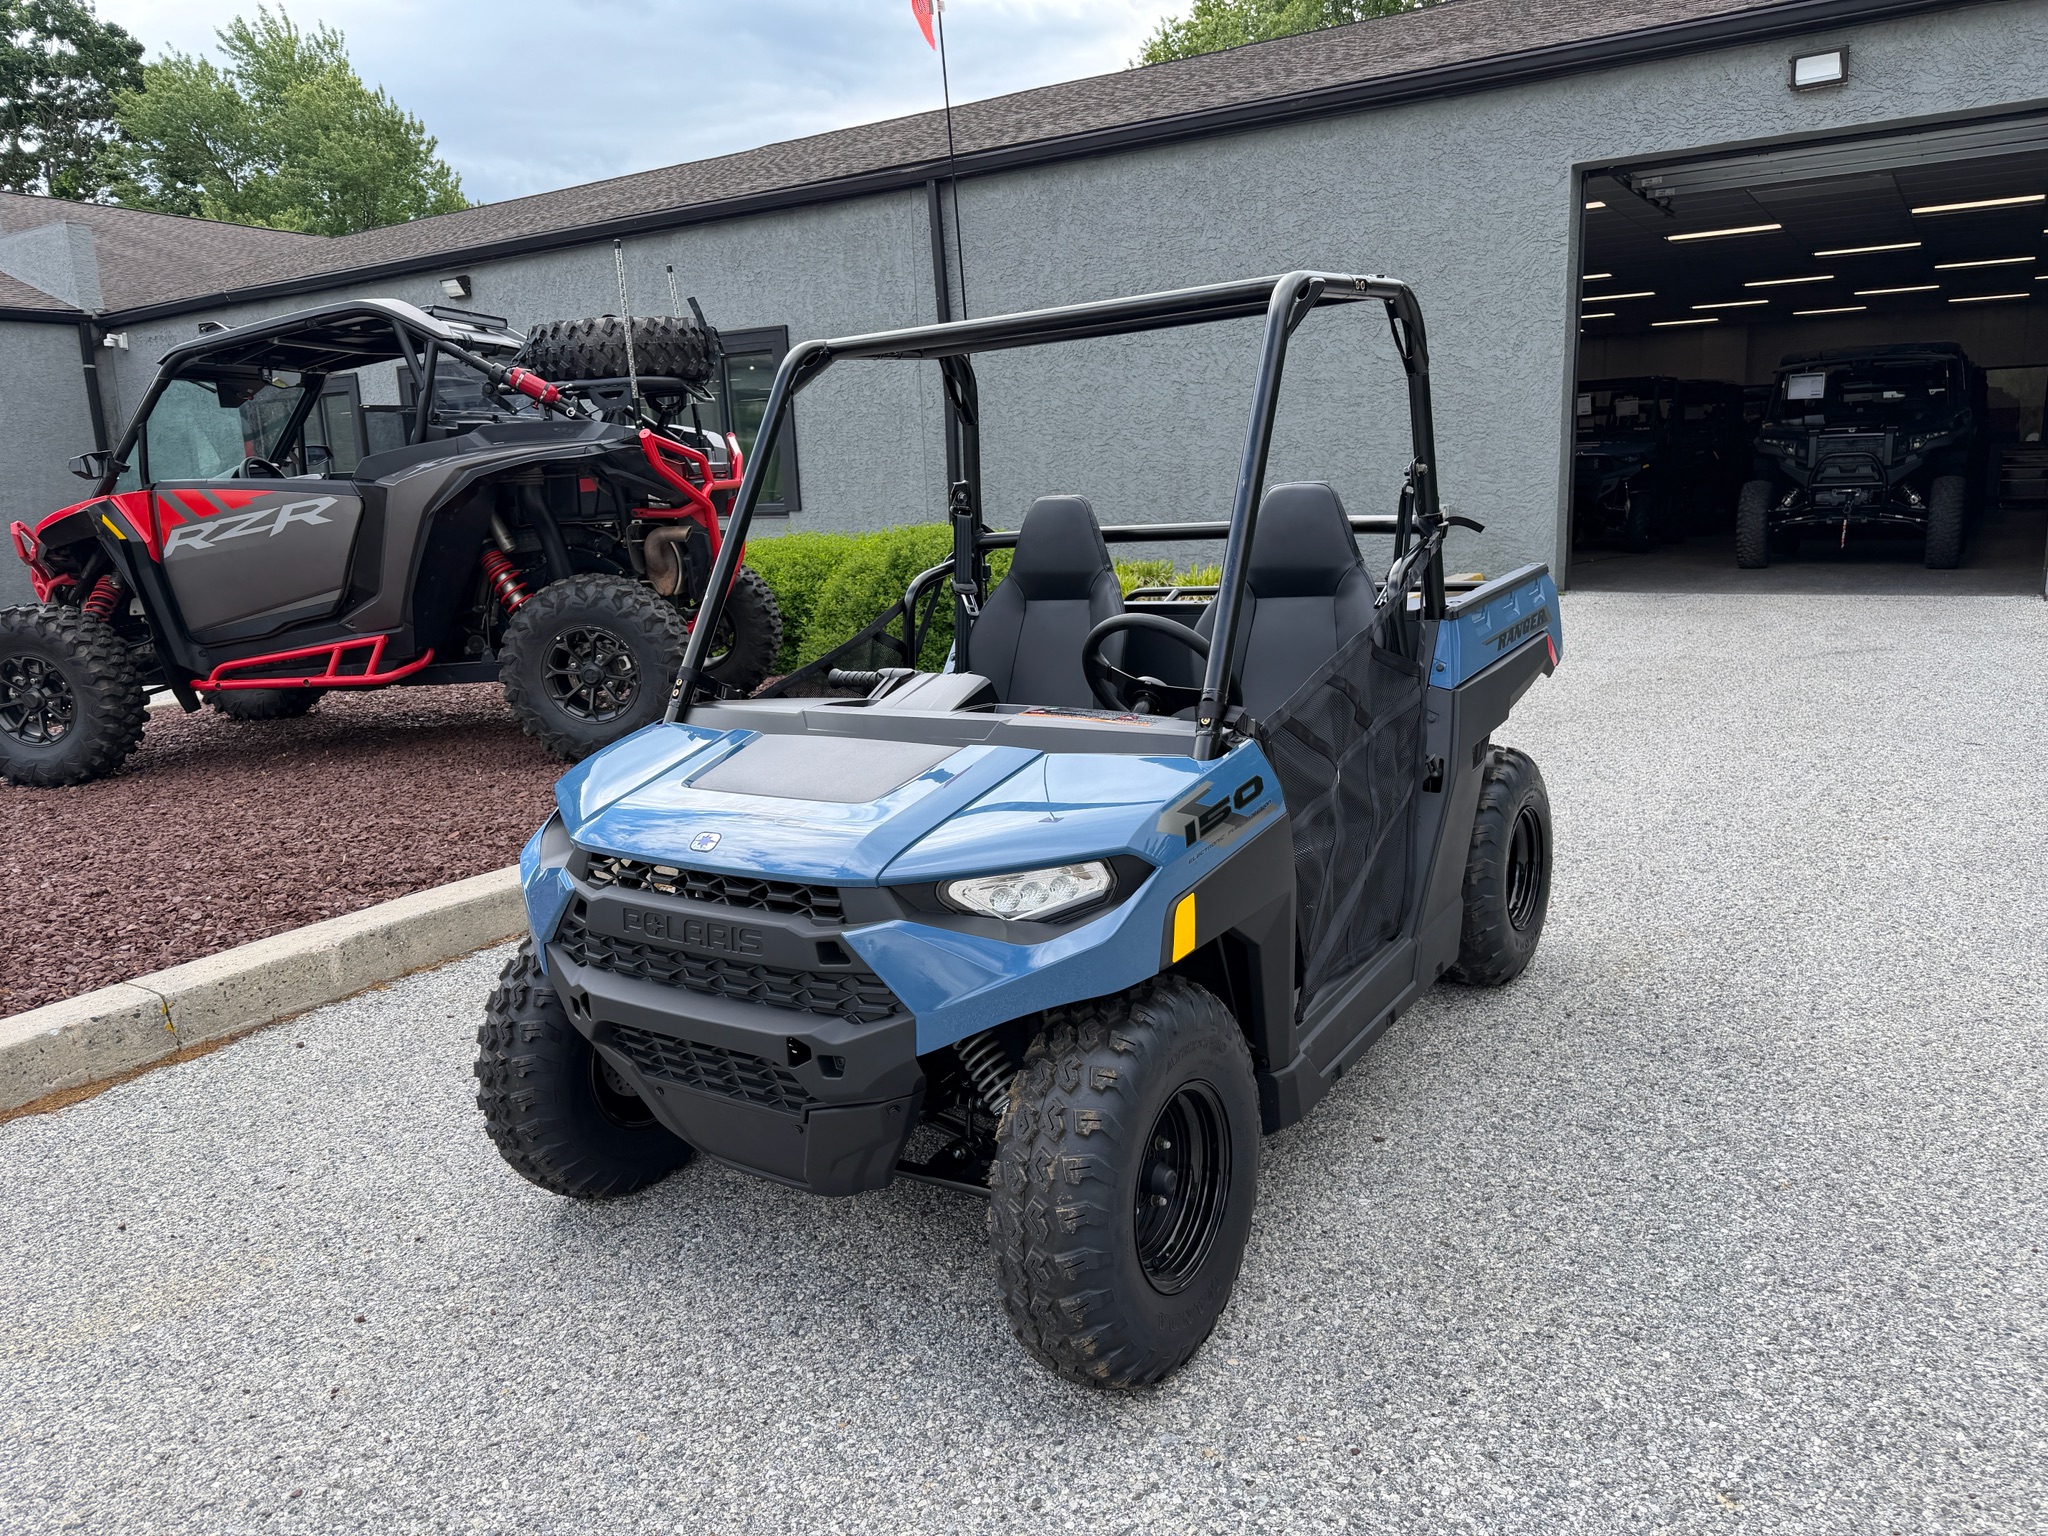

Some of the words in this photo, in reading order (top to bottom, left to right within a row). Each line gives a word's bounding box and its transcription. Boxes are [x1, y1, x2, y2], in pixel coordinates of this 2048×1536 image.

[164, 496, 338, 559] RZR
[1497, 609, 1546, 652] RANGER
[1185, 775, 1264, 848] 150
[623, 907, 763, 957] POLARIS
